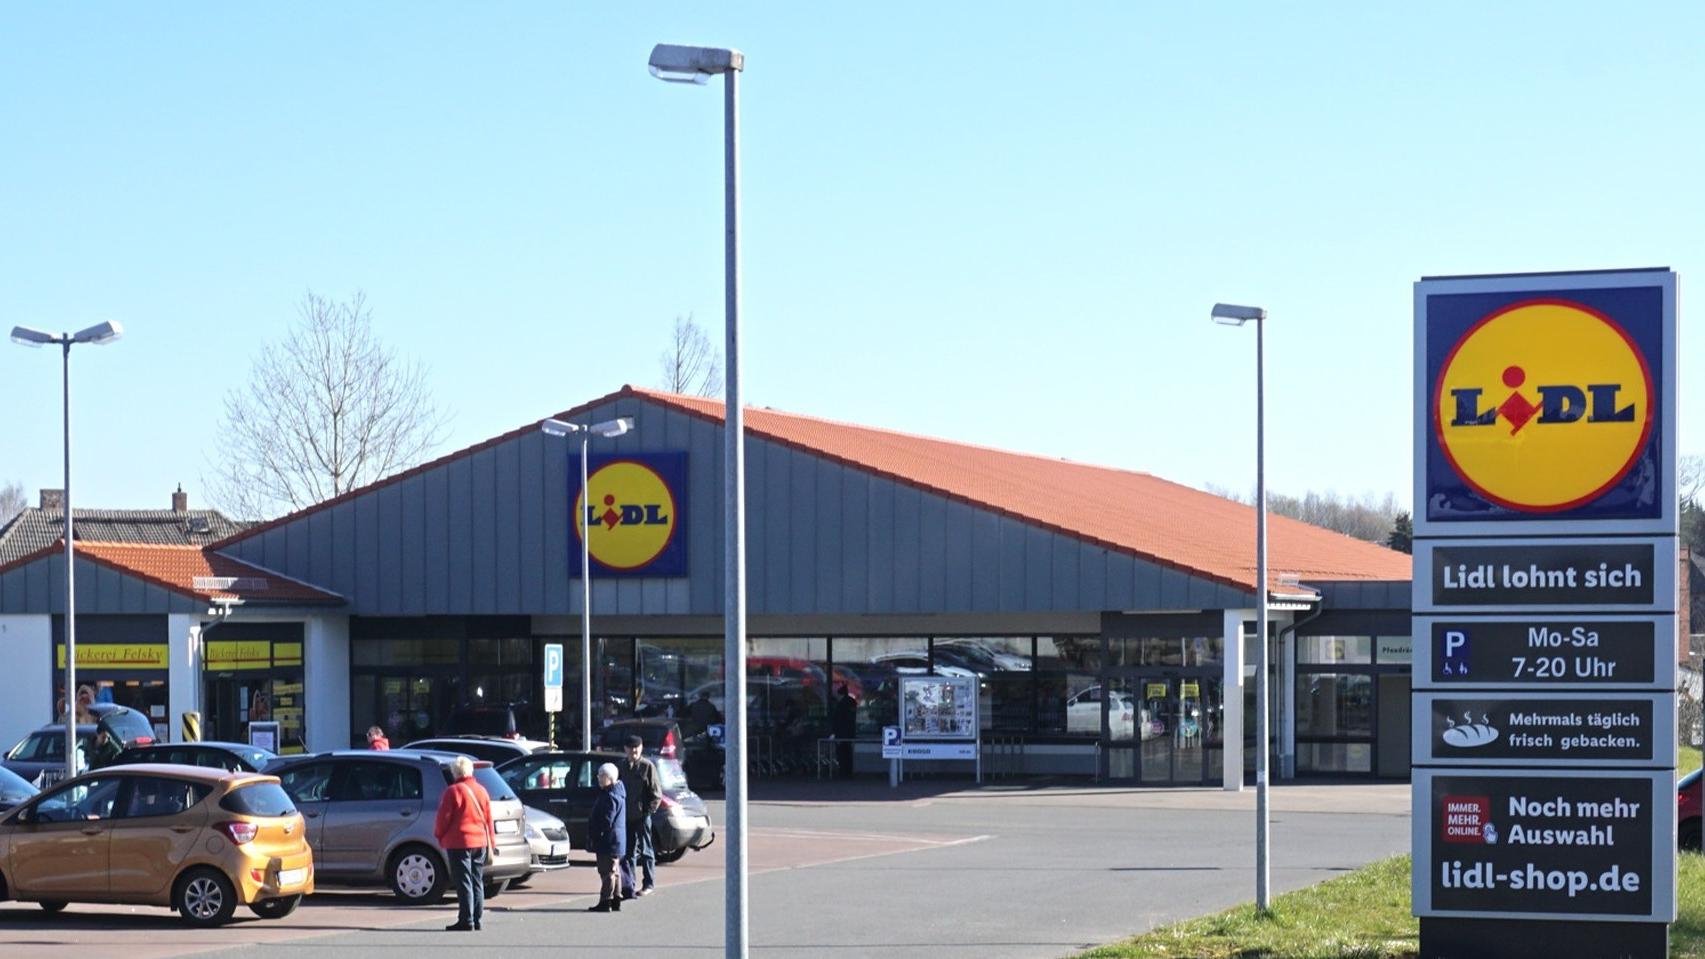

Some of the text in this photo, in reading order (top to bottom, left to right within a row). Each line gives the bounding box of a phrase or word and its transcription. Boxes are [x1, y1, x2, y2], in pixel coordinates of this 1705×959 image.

[1443, 563, 1642, 589] Lidl lohnt sich
[1446, 631, 1465, 657] P
[1528, 626, 1599, 647] Mo-Sa
[123, 648, 163, 661] Felsky
[548, 650, 560, 682] P
[1512, 656, 1616, 678] 7-20 Uhr
[1509, 713, 1640, 729] Mehrmals täglich
[884, 728, 897, 745] P
[1509, 733, 1640, 750] frisch gebacken.
[1447, 803, 1481, 813] IMMER.
[1509, 796, 1640, 819] Noch mehr
[1447, 814, 1481, 826] MEHR.
[1447, 826, 1481, 837] ONLINE.
[1508, 824, 1614, 846] Auswahl
[1442, 861, 1640, 898] lidl-shop.de
